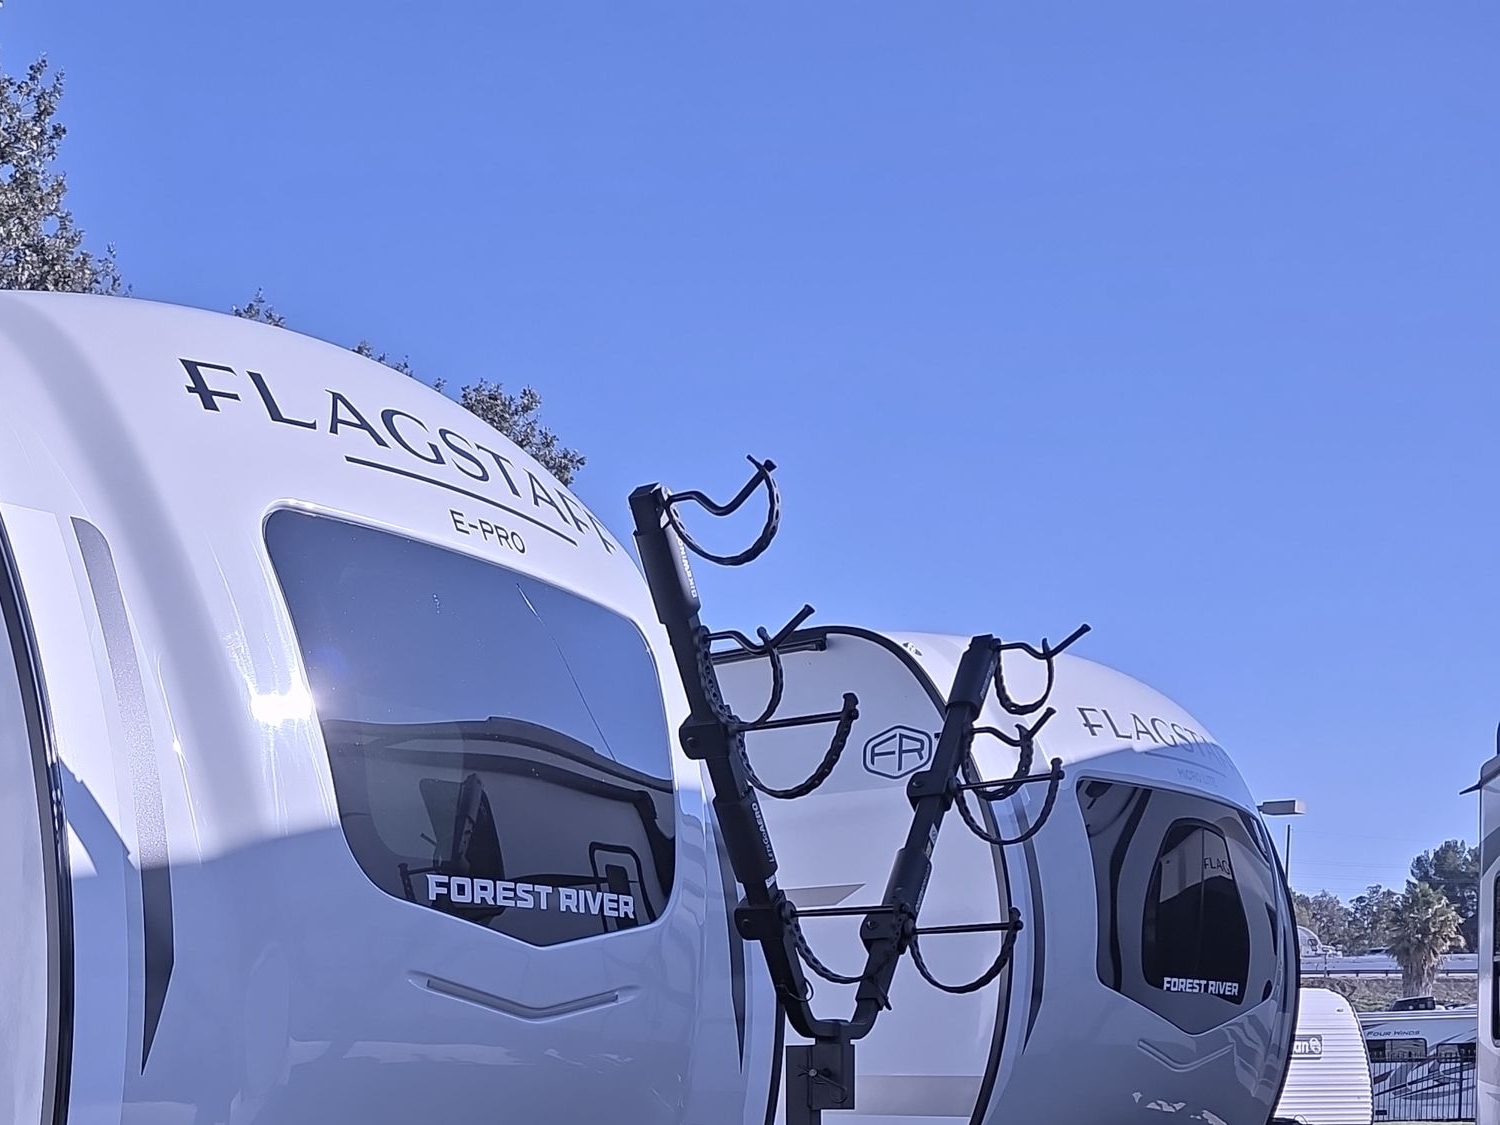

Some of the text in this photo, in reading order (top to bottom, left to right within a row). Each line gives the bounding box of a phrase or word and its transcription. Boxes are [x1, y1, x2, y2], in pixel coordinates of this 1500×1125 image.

[179, 358, 616, 554] FLAGSTAFF
[449, 508, 526, 555] E-PRO
[425, 873, 635, 919] FOREST RIVER
[1163, 976, 1239, 996] FOREST RIVER
